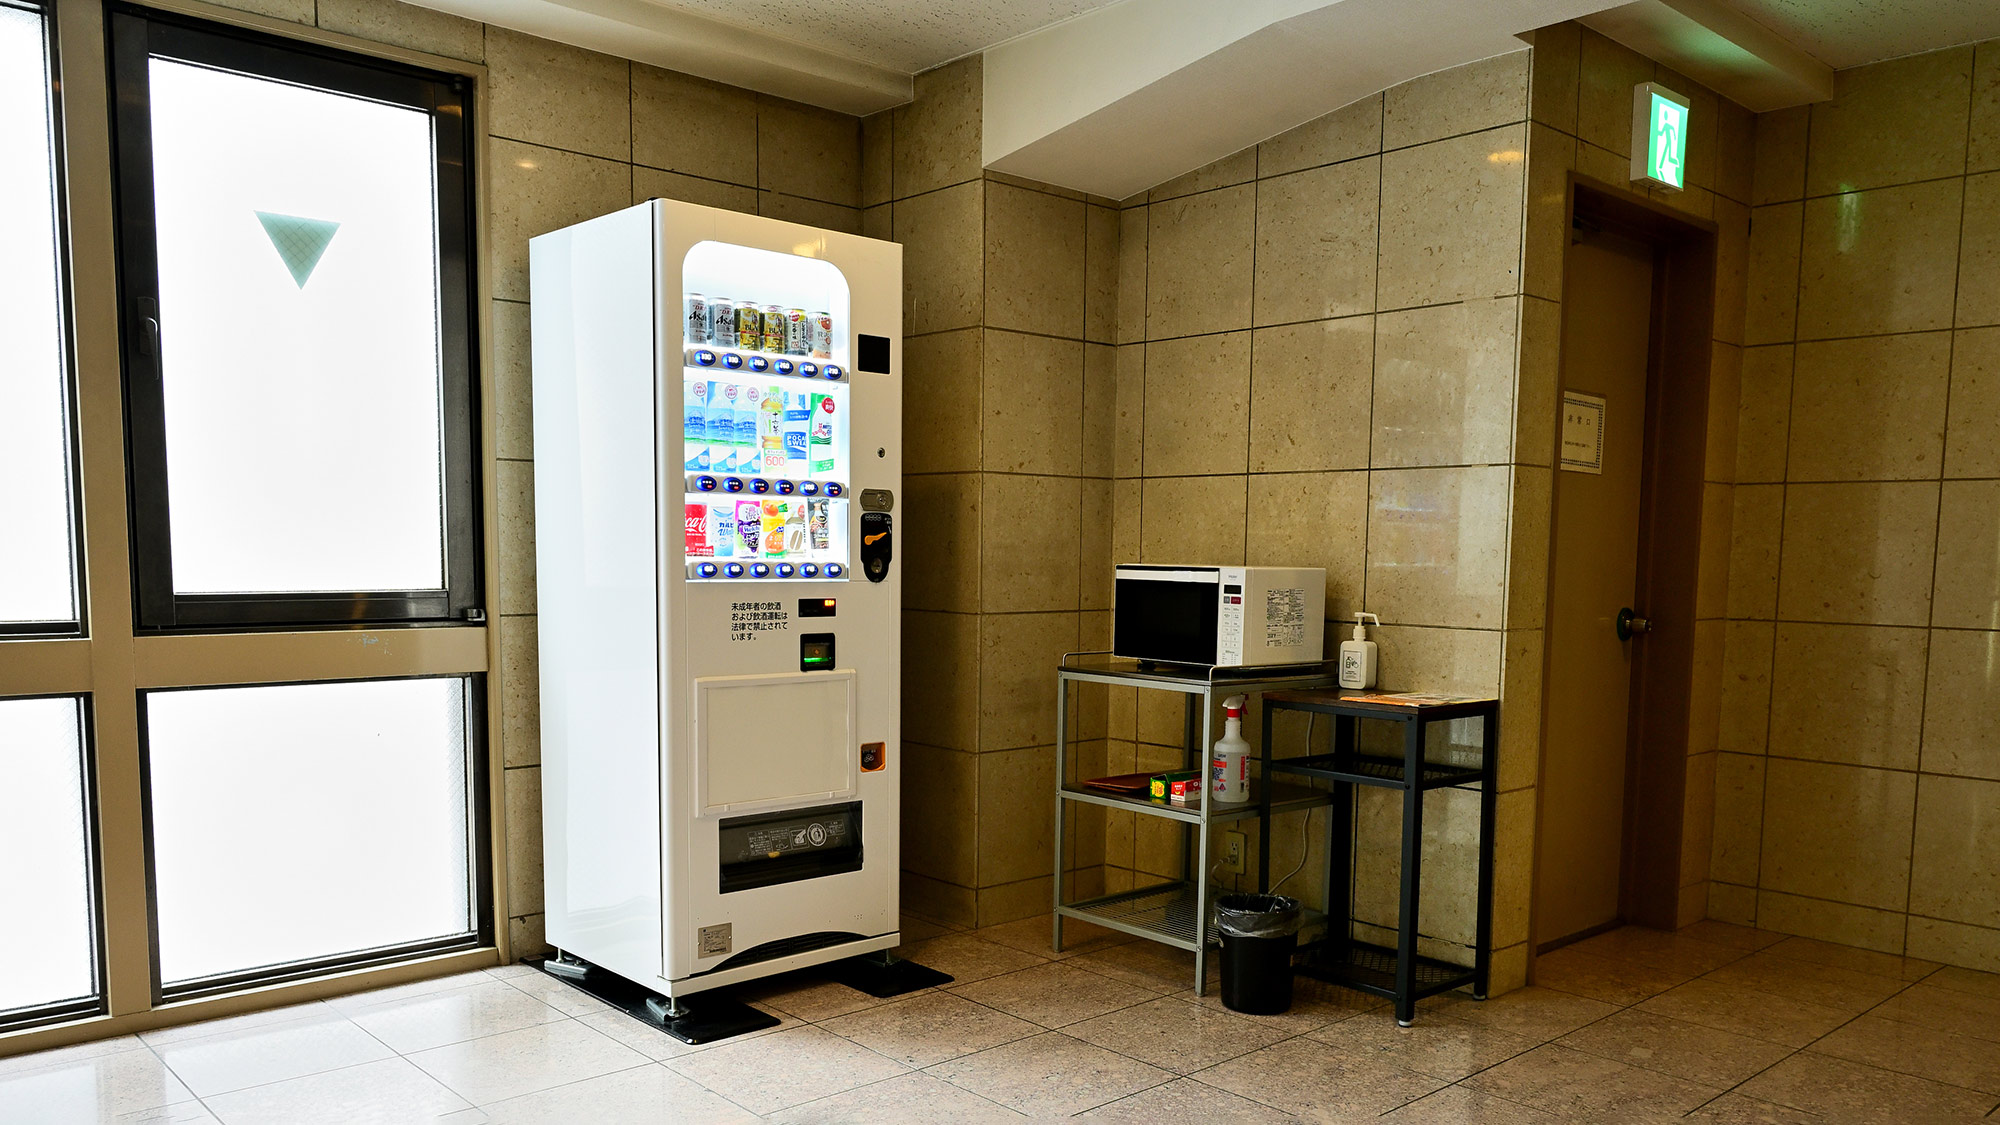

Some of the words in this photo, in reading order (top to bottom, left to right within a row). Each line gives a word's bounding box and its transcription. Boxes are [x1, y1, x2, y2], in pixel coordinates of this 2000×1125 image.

[766, 456, 784, 466] 600
[731, 602, 781, 611] 未成年者の飲酒
[731, 612, 788, 621] および飲酒運転は
[731, 622, 788, 631] 法律で禁止されて
[731, 632, 757, 641] います。
